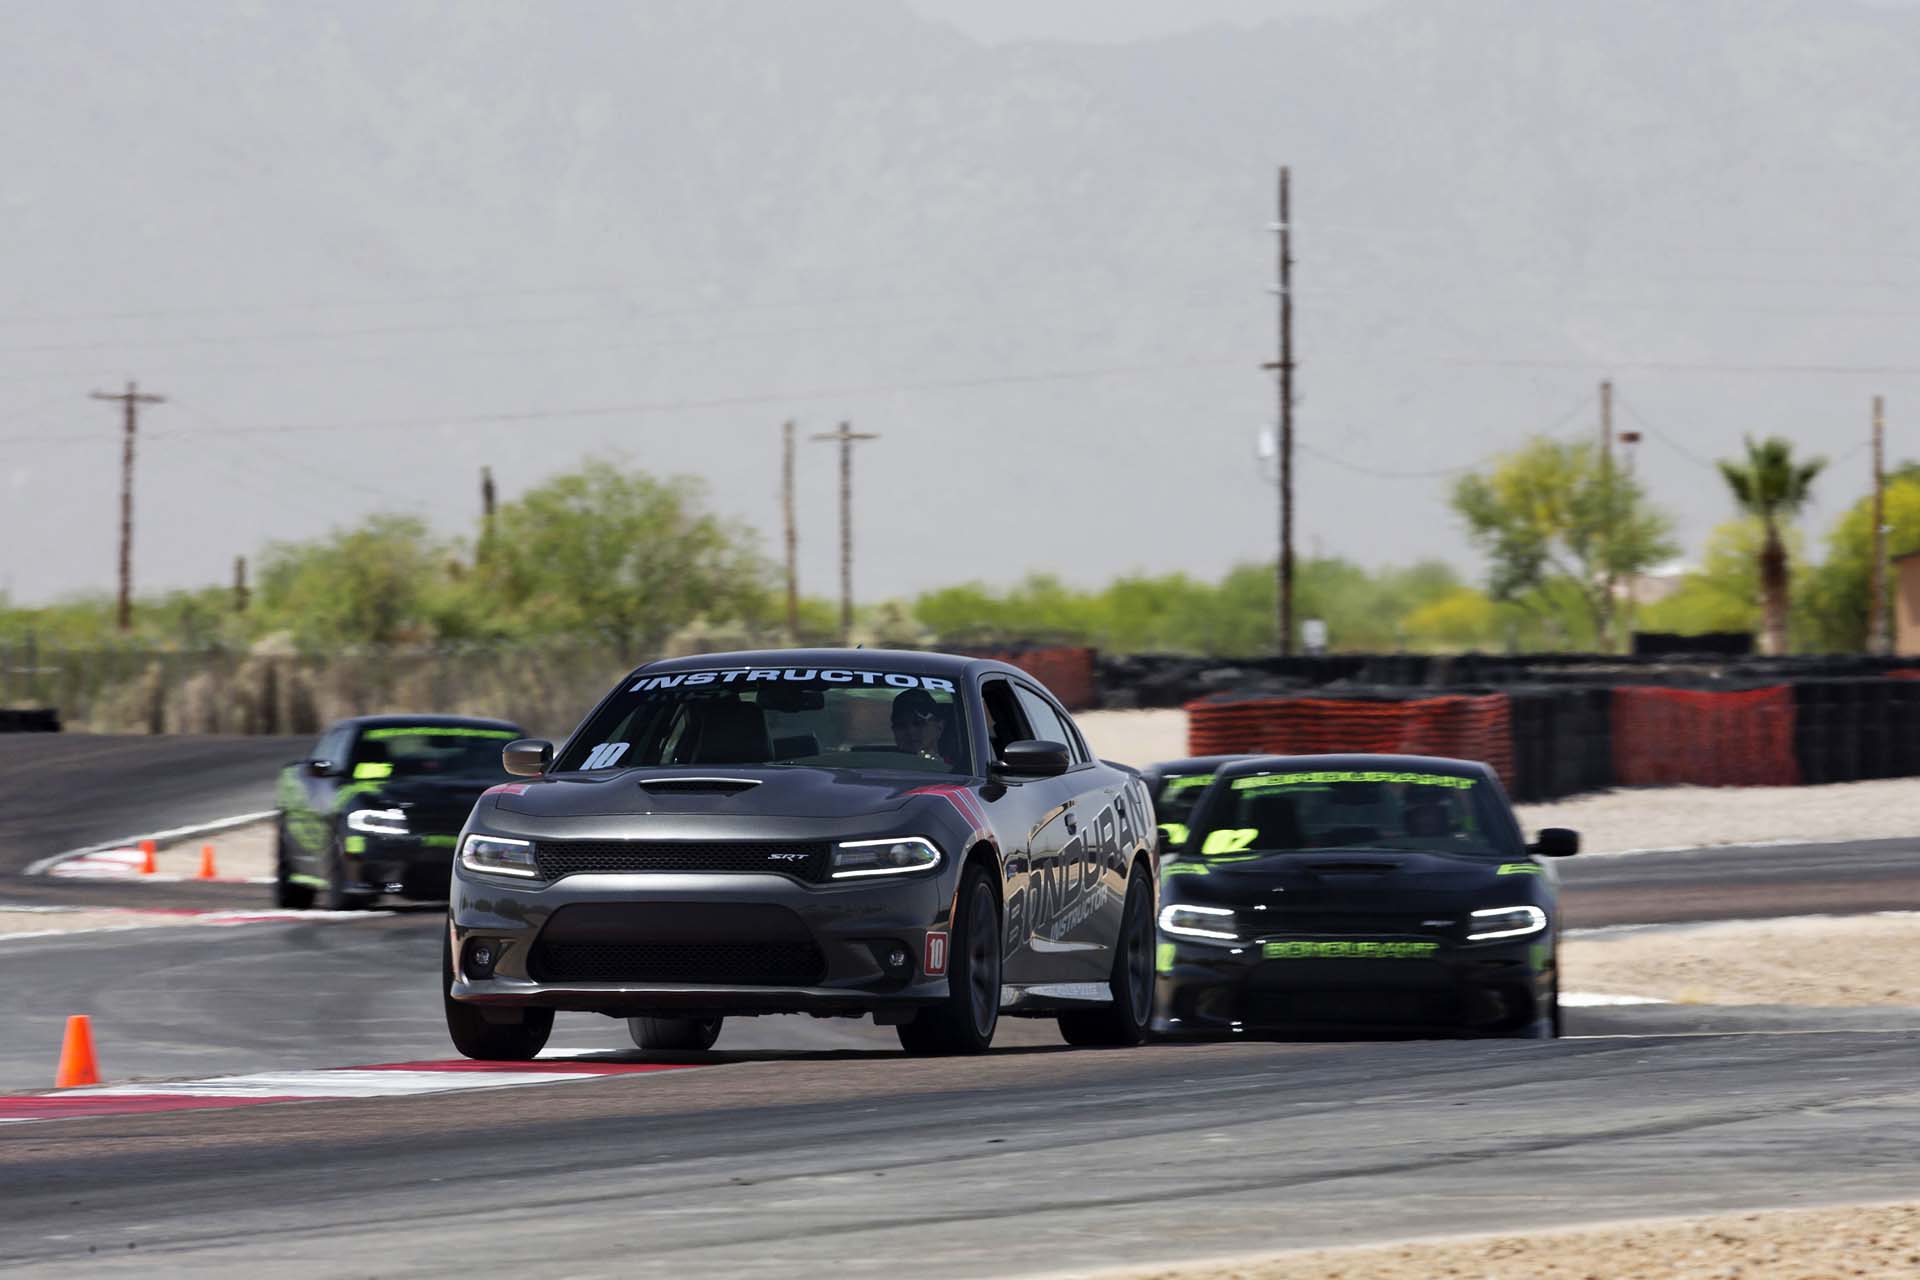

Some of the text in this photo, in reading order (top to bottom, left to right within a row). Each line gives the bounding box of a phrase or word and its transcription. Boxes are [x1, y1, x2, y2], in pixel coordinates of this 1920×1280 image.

[629, 668, 955, 693] INSTRUCTOR
[579, 742, 630, 770] 10
[767, 853, 809, 862] SRT
[1051, 884, 1108, 943] INSTRUCTOR
[930, 938, 944, 969] 10
